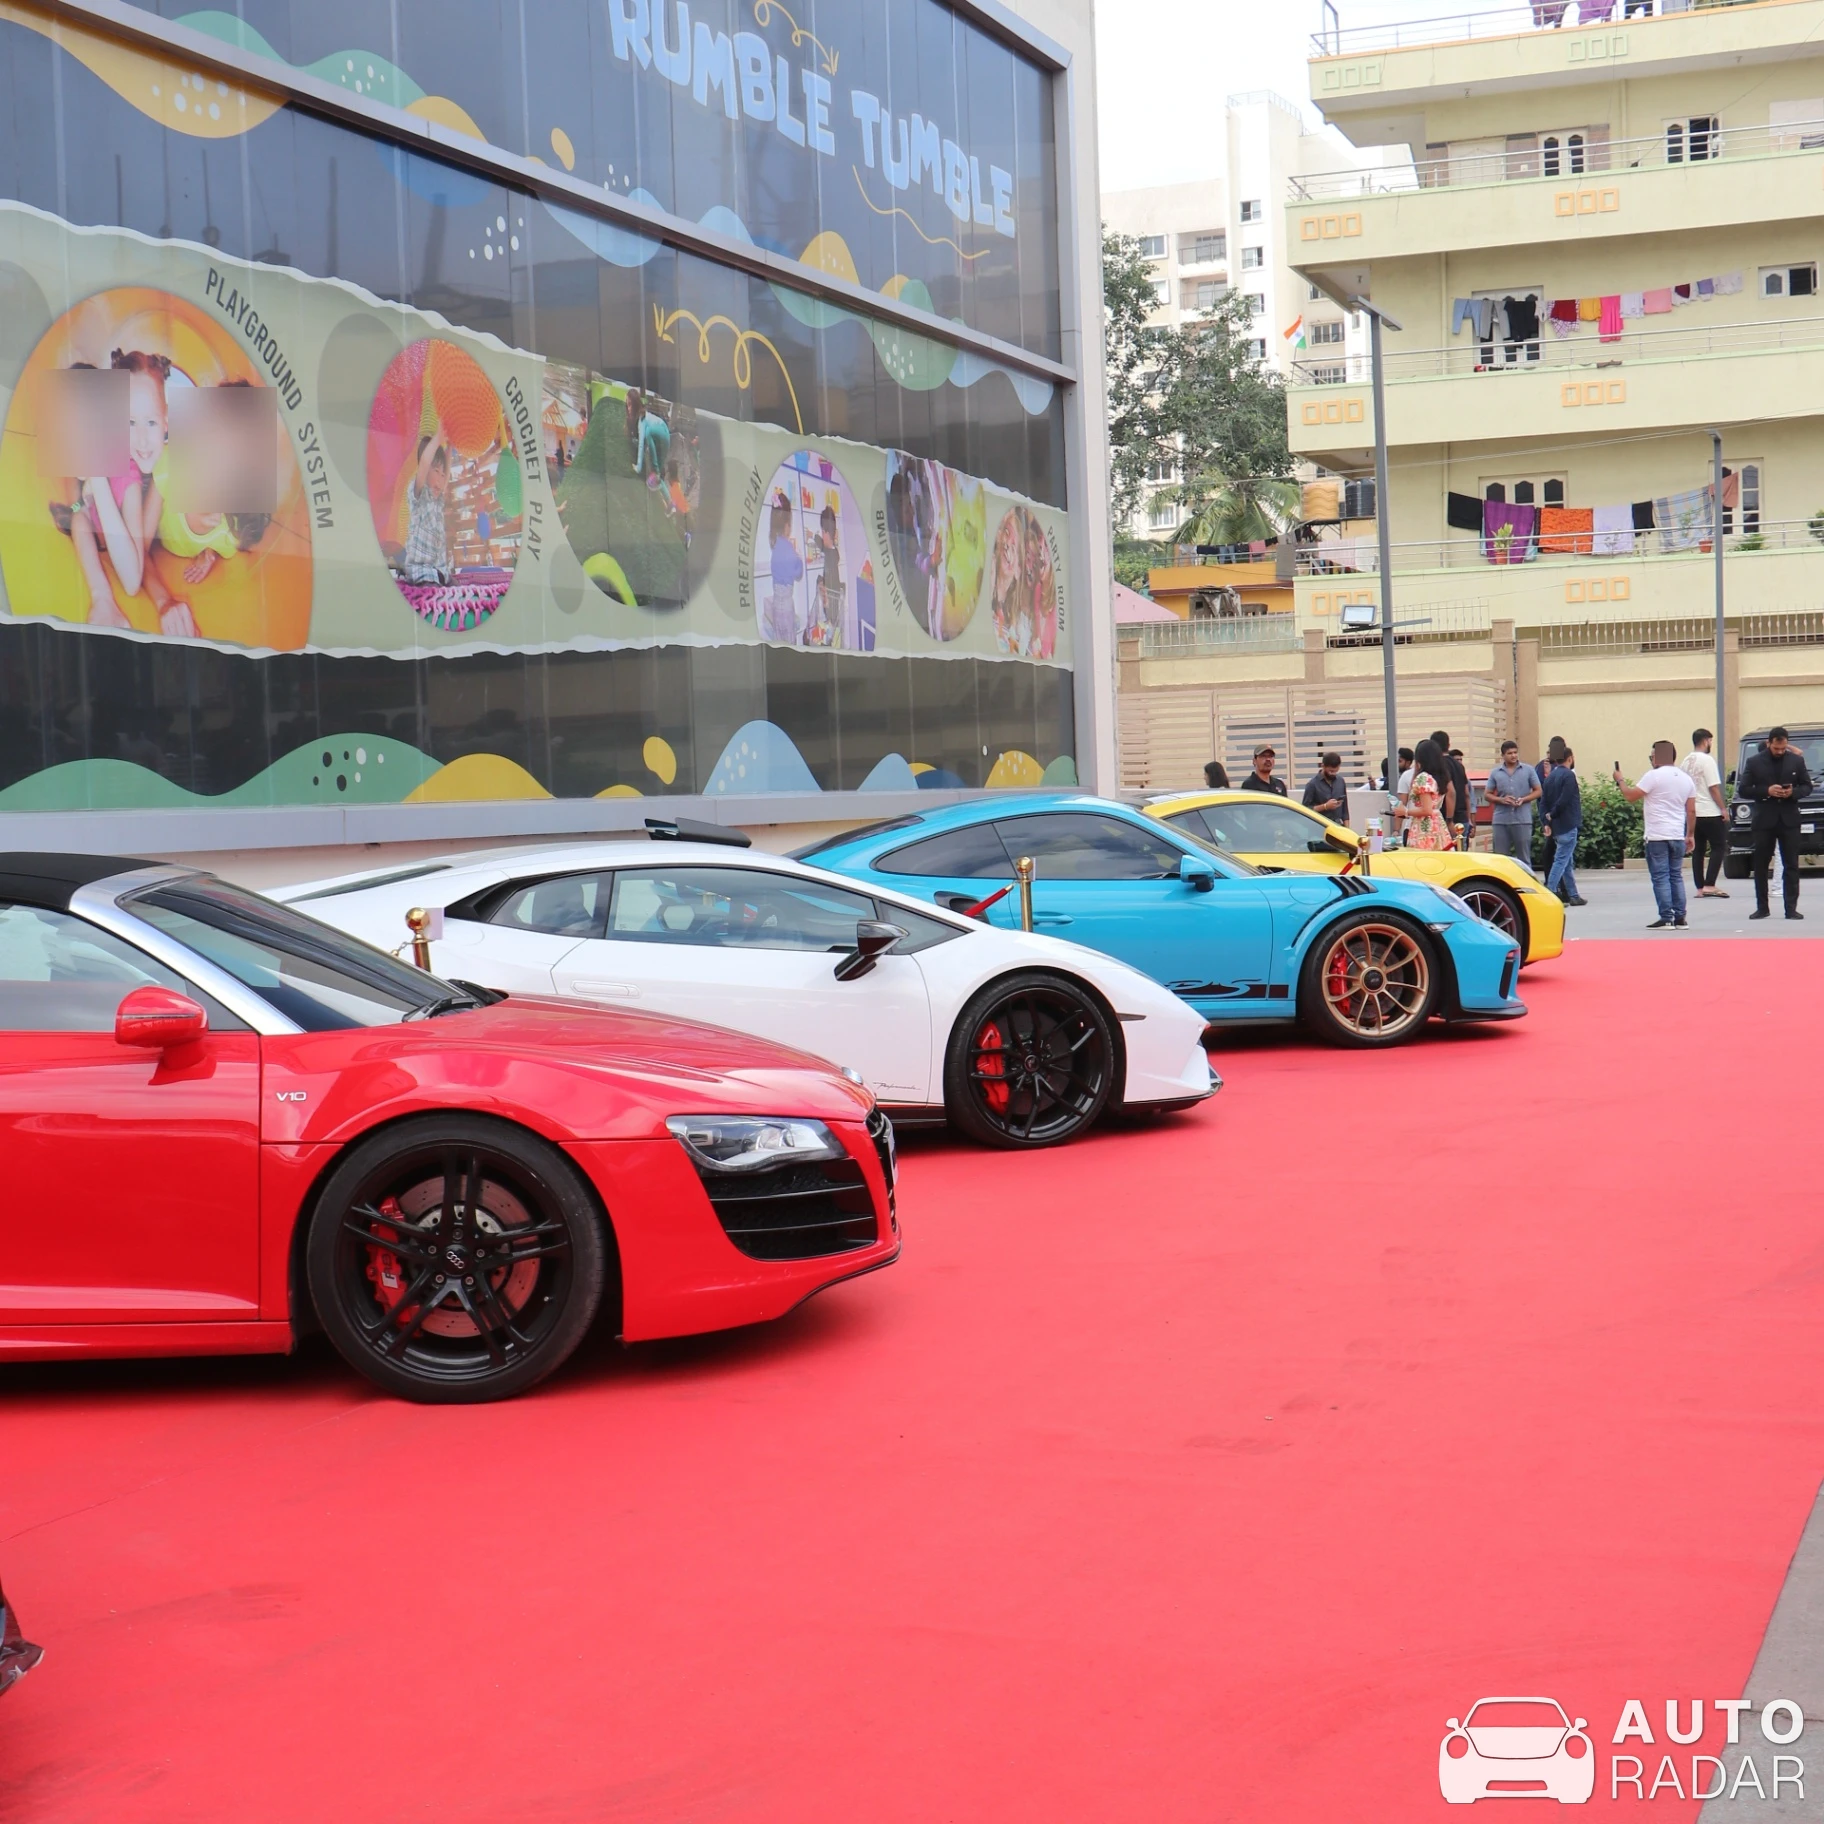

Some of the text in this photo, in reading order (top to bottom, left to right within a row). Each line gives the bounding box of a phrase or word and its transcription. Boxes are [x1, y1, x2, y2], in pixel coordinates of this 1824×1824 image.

[608, 0, 1016, 239] RUMBLE TUMBLE
[204, 267, 334, 529] PLAYGROUND SYSTEM
[505, 376, 543, 561] CROCHET PLAY
[737, 465, 763, 609] PRETEND PLAY
[876, 510, 891, 568] CLIMB
[1047, 525, 1065, 632] PARTY ROOM
[275, 1091, 307, 1102] V10
